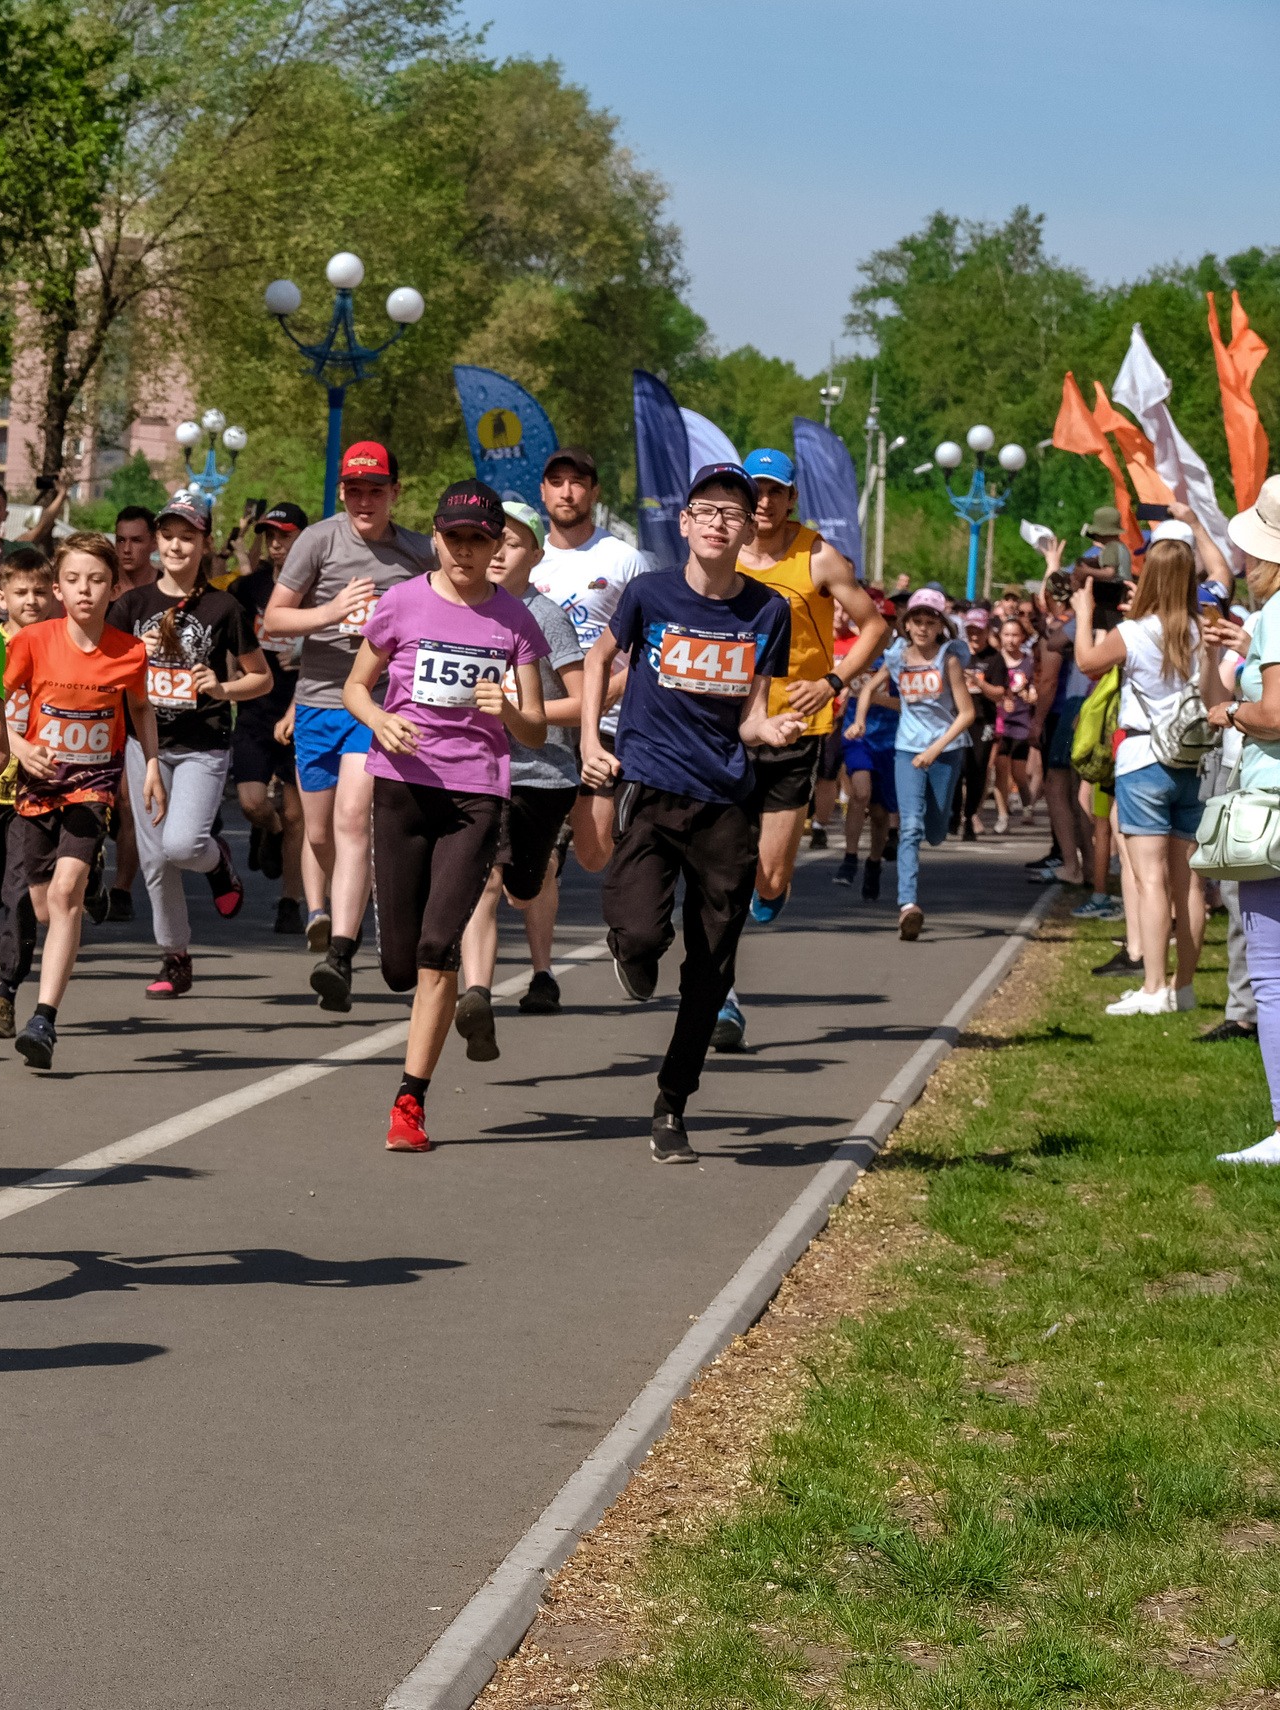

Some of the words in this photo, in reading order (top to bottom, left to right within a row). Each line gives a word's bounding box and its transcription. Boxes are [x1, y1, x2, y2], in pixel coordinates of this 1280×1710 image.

[419, 657, 500, 688] 1530
[664, 640, 748, 680] 441
[900, 672, 939, 694] 440
[38, 719, 110, 751] 406
